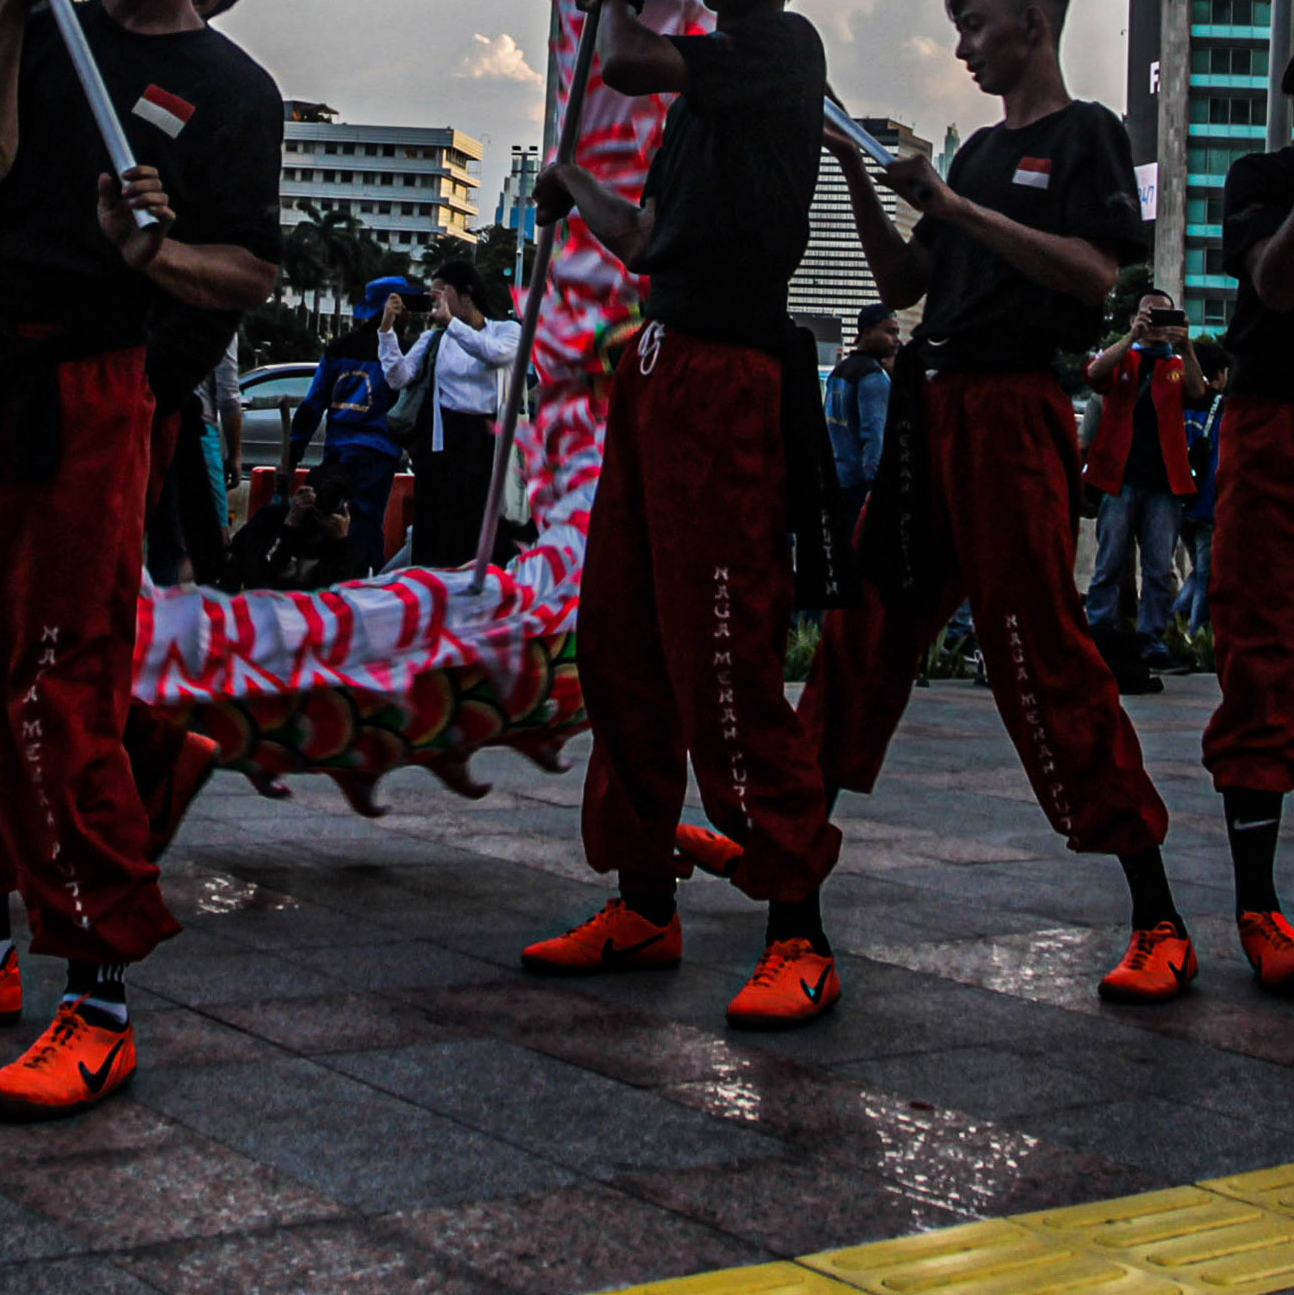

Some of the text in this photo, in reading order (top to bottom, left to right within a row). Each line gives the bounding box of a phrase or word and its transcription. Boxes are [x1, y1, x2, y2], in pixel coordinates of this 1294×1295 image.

[712, 564, 732, 639] NAGA
[713, 651, 738, 742] MERAH
[1005, 613, 1030, 681] NAGA
[1020, 692, 1056, 776] MERAH
